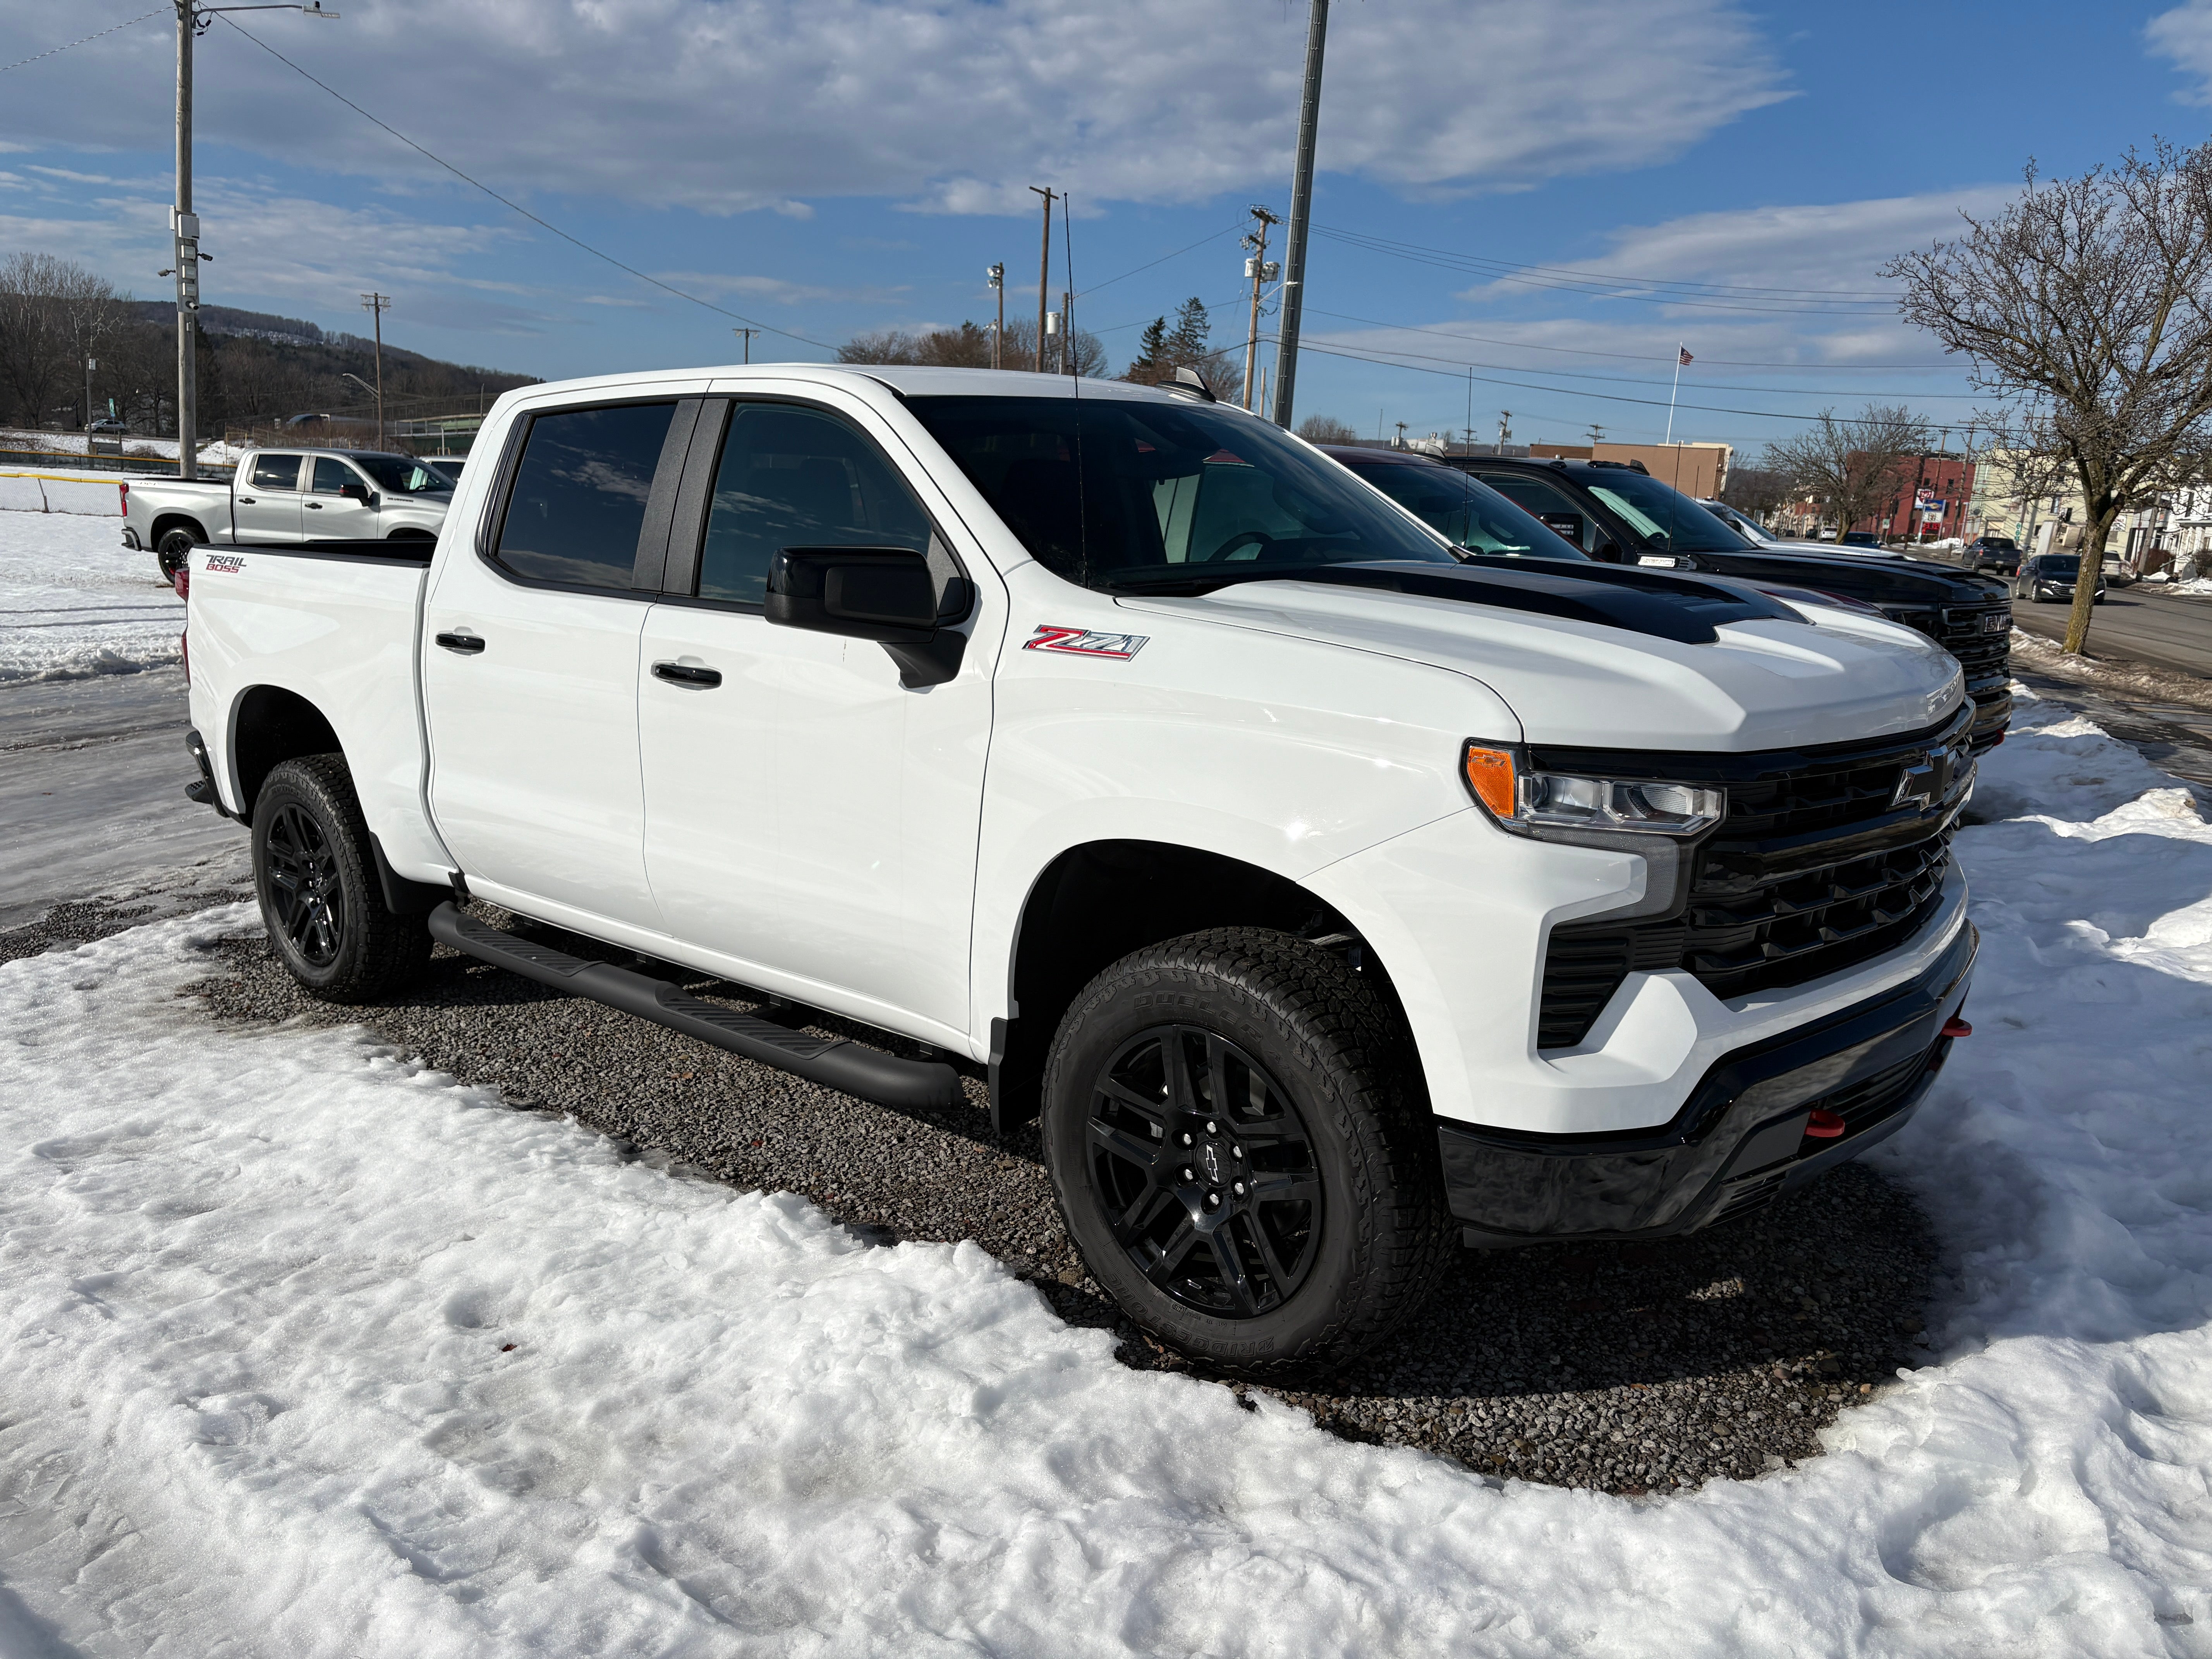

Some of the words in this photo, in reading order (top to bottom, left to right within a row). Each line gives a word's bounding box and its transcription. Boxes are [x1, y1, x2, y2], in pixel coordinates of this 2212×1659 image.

[206, 555, 247, 567] TRAIL
[206, 564, 240, 573] BOSS
[1022, 624, 1151, 662] Z71
[1134, 991, 1262, 1042] DUELER
[1104, 1273, 1274, 1357] BRIDGESTONE
